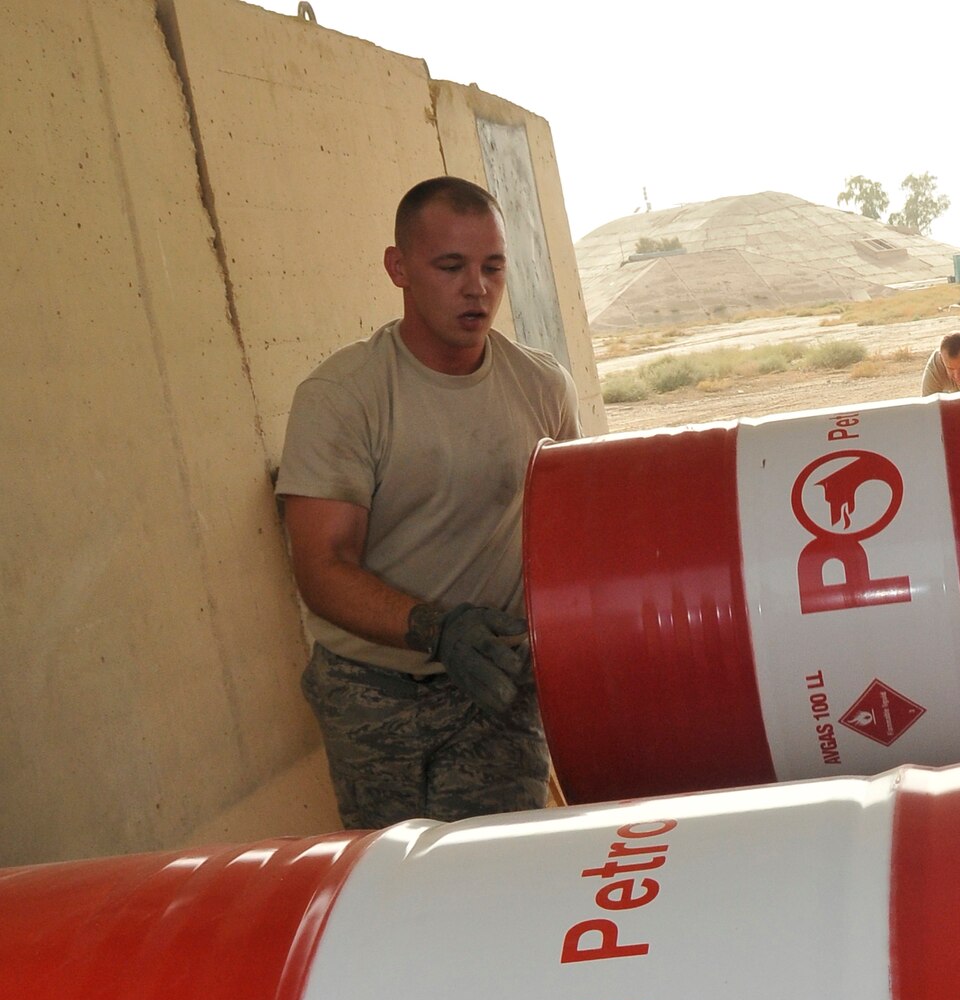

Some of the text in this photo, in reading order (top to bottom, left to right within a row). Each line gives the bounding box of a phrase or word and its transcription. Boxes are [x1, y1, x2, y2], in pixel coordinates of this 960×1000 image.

[806, 669, 842, 765] AVGAS 100 LL
